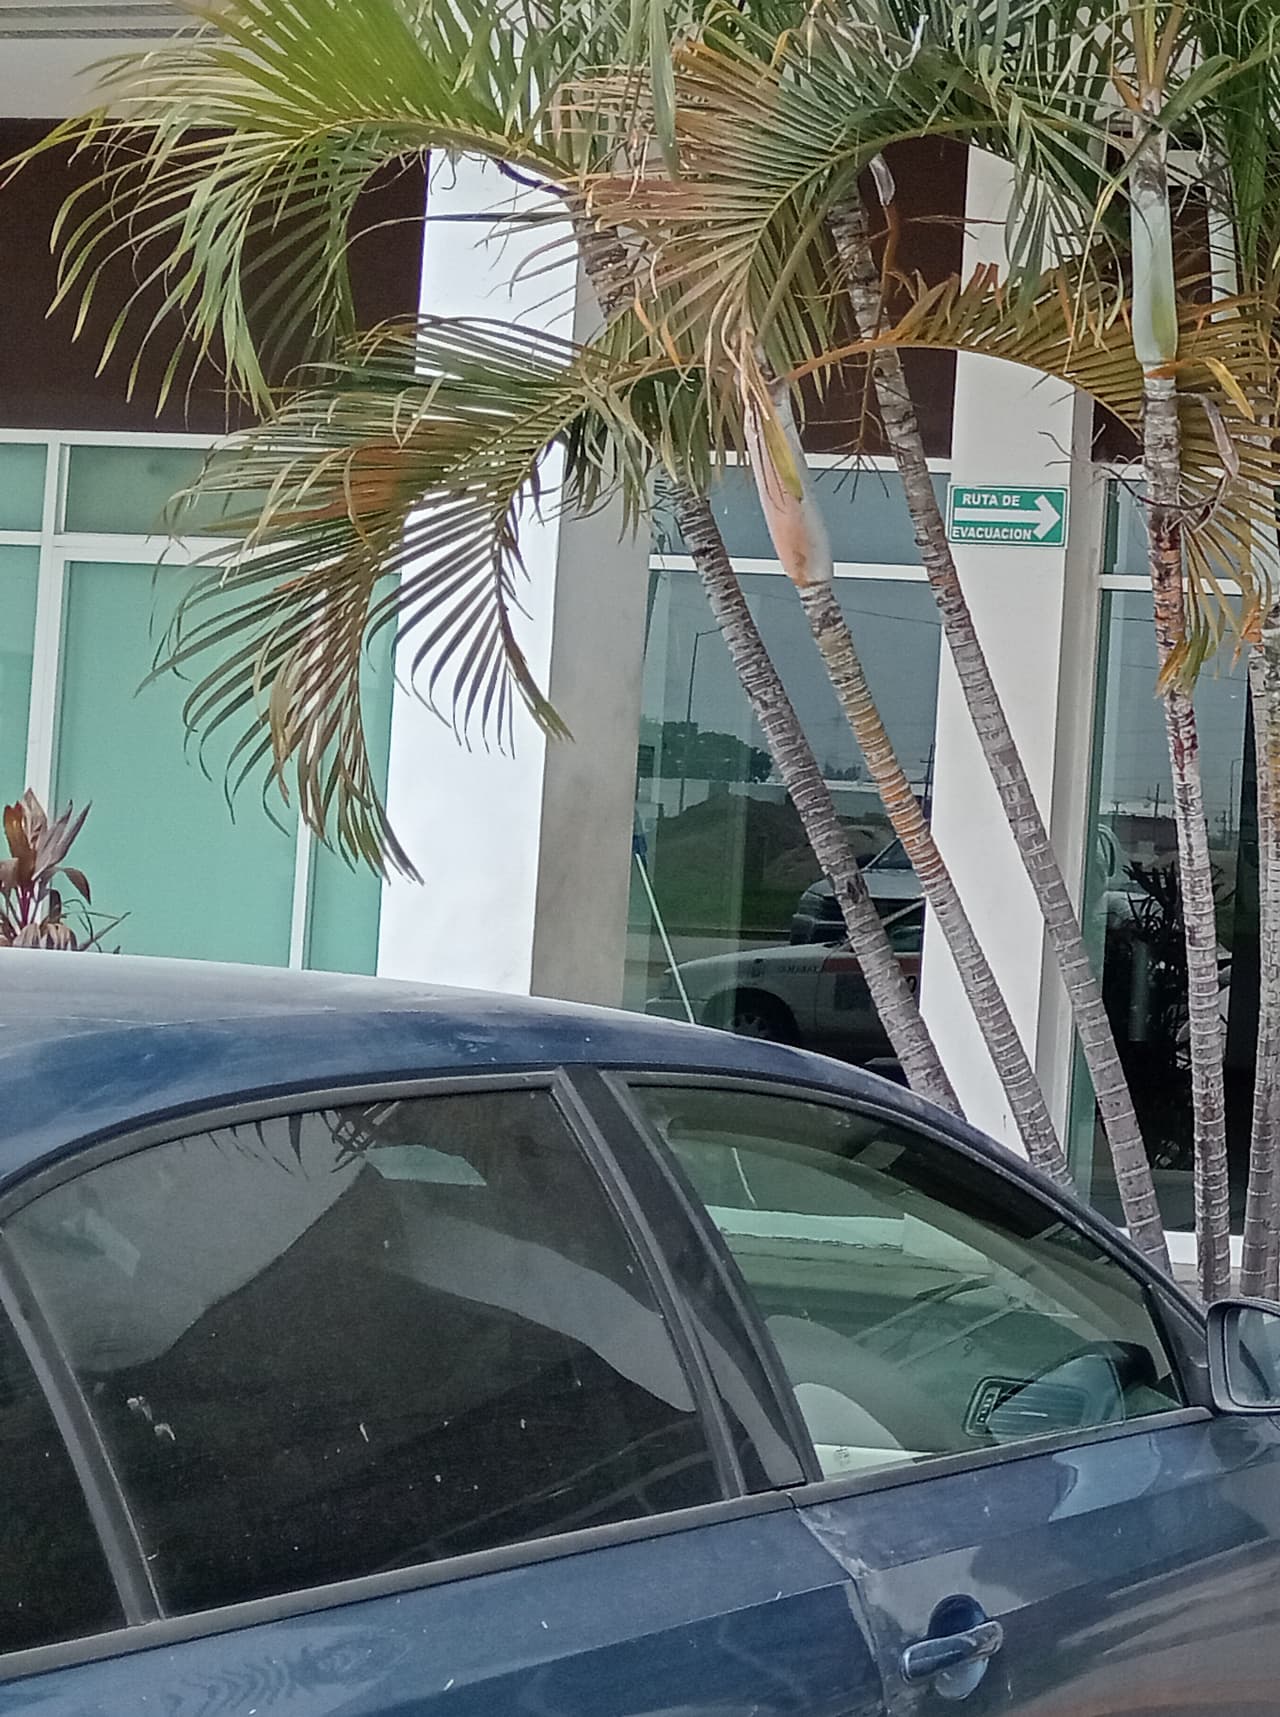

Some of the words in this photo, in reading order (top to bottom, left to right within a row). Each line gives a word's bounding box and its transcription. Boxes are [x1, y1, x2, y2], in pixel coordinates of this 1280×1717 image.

[962, 493, 998, 506] RUTA
[1002, 495, 1021, 507] DE
[952, 527, 1032, 540] EVACUACION
